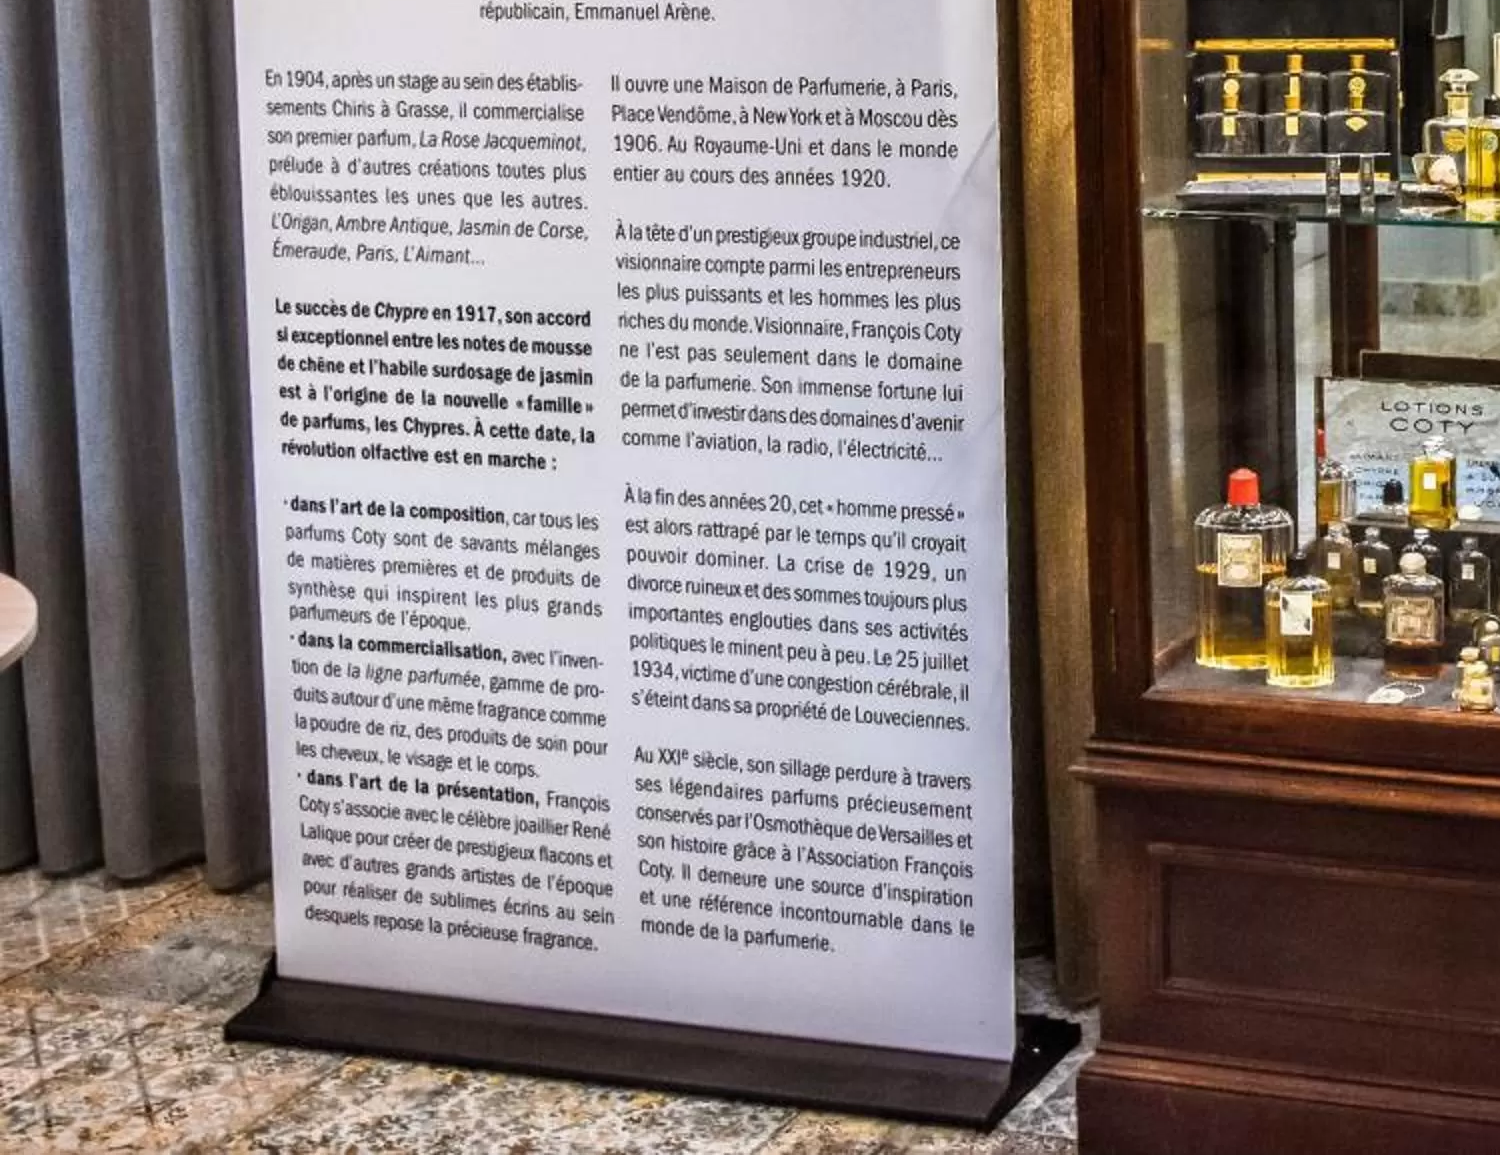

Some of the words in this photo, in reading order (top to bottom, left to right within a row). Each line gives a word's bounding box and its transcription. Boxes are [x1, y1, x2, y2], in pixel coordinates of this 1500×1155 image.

[610, 74, 621, 93] Il
[623, 78, 670, 95] ouvre
[672, 78, 705, 94] une
[708, 75, 769, 96] Maison
[771, 76, 794, 96] de
[797, 76, 892, 100] Parfumerie,
[894, 77, 906, 99] à
[910, 78, 959, 101] Paris,
[265, 100, 328, 118] sements
[331, 97, 376, 119] Chiris
[378, 98, 392, 119] à
[394, 99, 455, 122] Grasse,
[458, 100, 468, 120] il
[472, 102, 585, 123] commercialise
[613, 132, 664, 156] 1906.
[666, 134, 688, 155] Au
[692, 134, 804, 158] Royaume-Uni
[807, 138, 827, 157] et
[829, 137, 871, 157] dans
[876, 137, 894, 158] le
[898, 140, 959, 160] monde
[612, 163, 661, 183] entier
[662, 167, 686, 184] au
[689, 167, 736, 185] cours
[738, 165, 771, 186] des
[774, 166, 835, 187] années
[841, 167, 891, 189] 1920.
[269, 182, 379, 205] éblouissantes
[384, 186, 410, 206] les
[416, 190, 457, 207] unes
[462, 191, 493, 211] que
[500, 190, 525, 209] les
[530, 192, 589, 211] autres.
[1380, 399, 1484, 416] LOTIONS
[279, 410, 300, 429] de
[301, 412, 372, 436] parfums,
[373, 414, 399, 434] les
[401, 415, 471, 440] Chypres.
[472, 415, 486, 438] À
[488, 421, 531, 441] cette
[533, 423, 577, 446] date,
[578, 425, 596, 445] la
[1389, 416, 1475, 435] COTY
[621, 431, 681, 449] comme
[685, 430, 763, 455] l'aviation,
[766, 434, 782, 454] la
[786, 436, 834, 459] radio,
[299, 821, 353, 846] Lalique
[354, 830, 390, 848] pour
[392, 830, 432, 851] créer
[432, 833, 453, 854] de
[455, 839, 537, 863] prestigieux
[538, 844, 595, 868] flacons
[596, 852, 614, 871] et
[639, 888, 657, 906] et
[661, 892, 692, 910] une
[698, 892, 774, 918] référence
[779, 900, 905, 931] incontournable
[910, 914, 953, 936] dans
[958, 918, 975, 938] le
[304, 904, 371, 928] desquels
[372, 914, 425, 933] repose
[427, 916, 443, 935] la
[446, 918, 519, 944] précieuse
[521, 926, 599, 952] fragrance.
[640, 918, 696, 939] monde
[698, 921, 721, 941] de
[723, 923, 740, 943] la
[743, 928, 835, 953] parfumerie.
